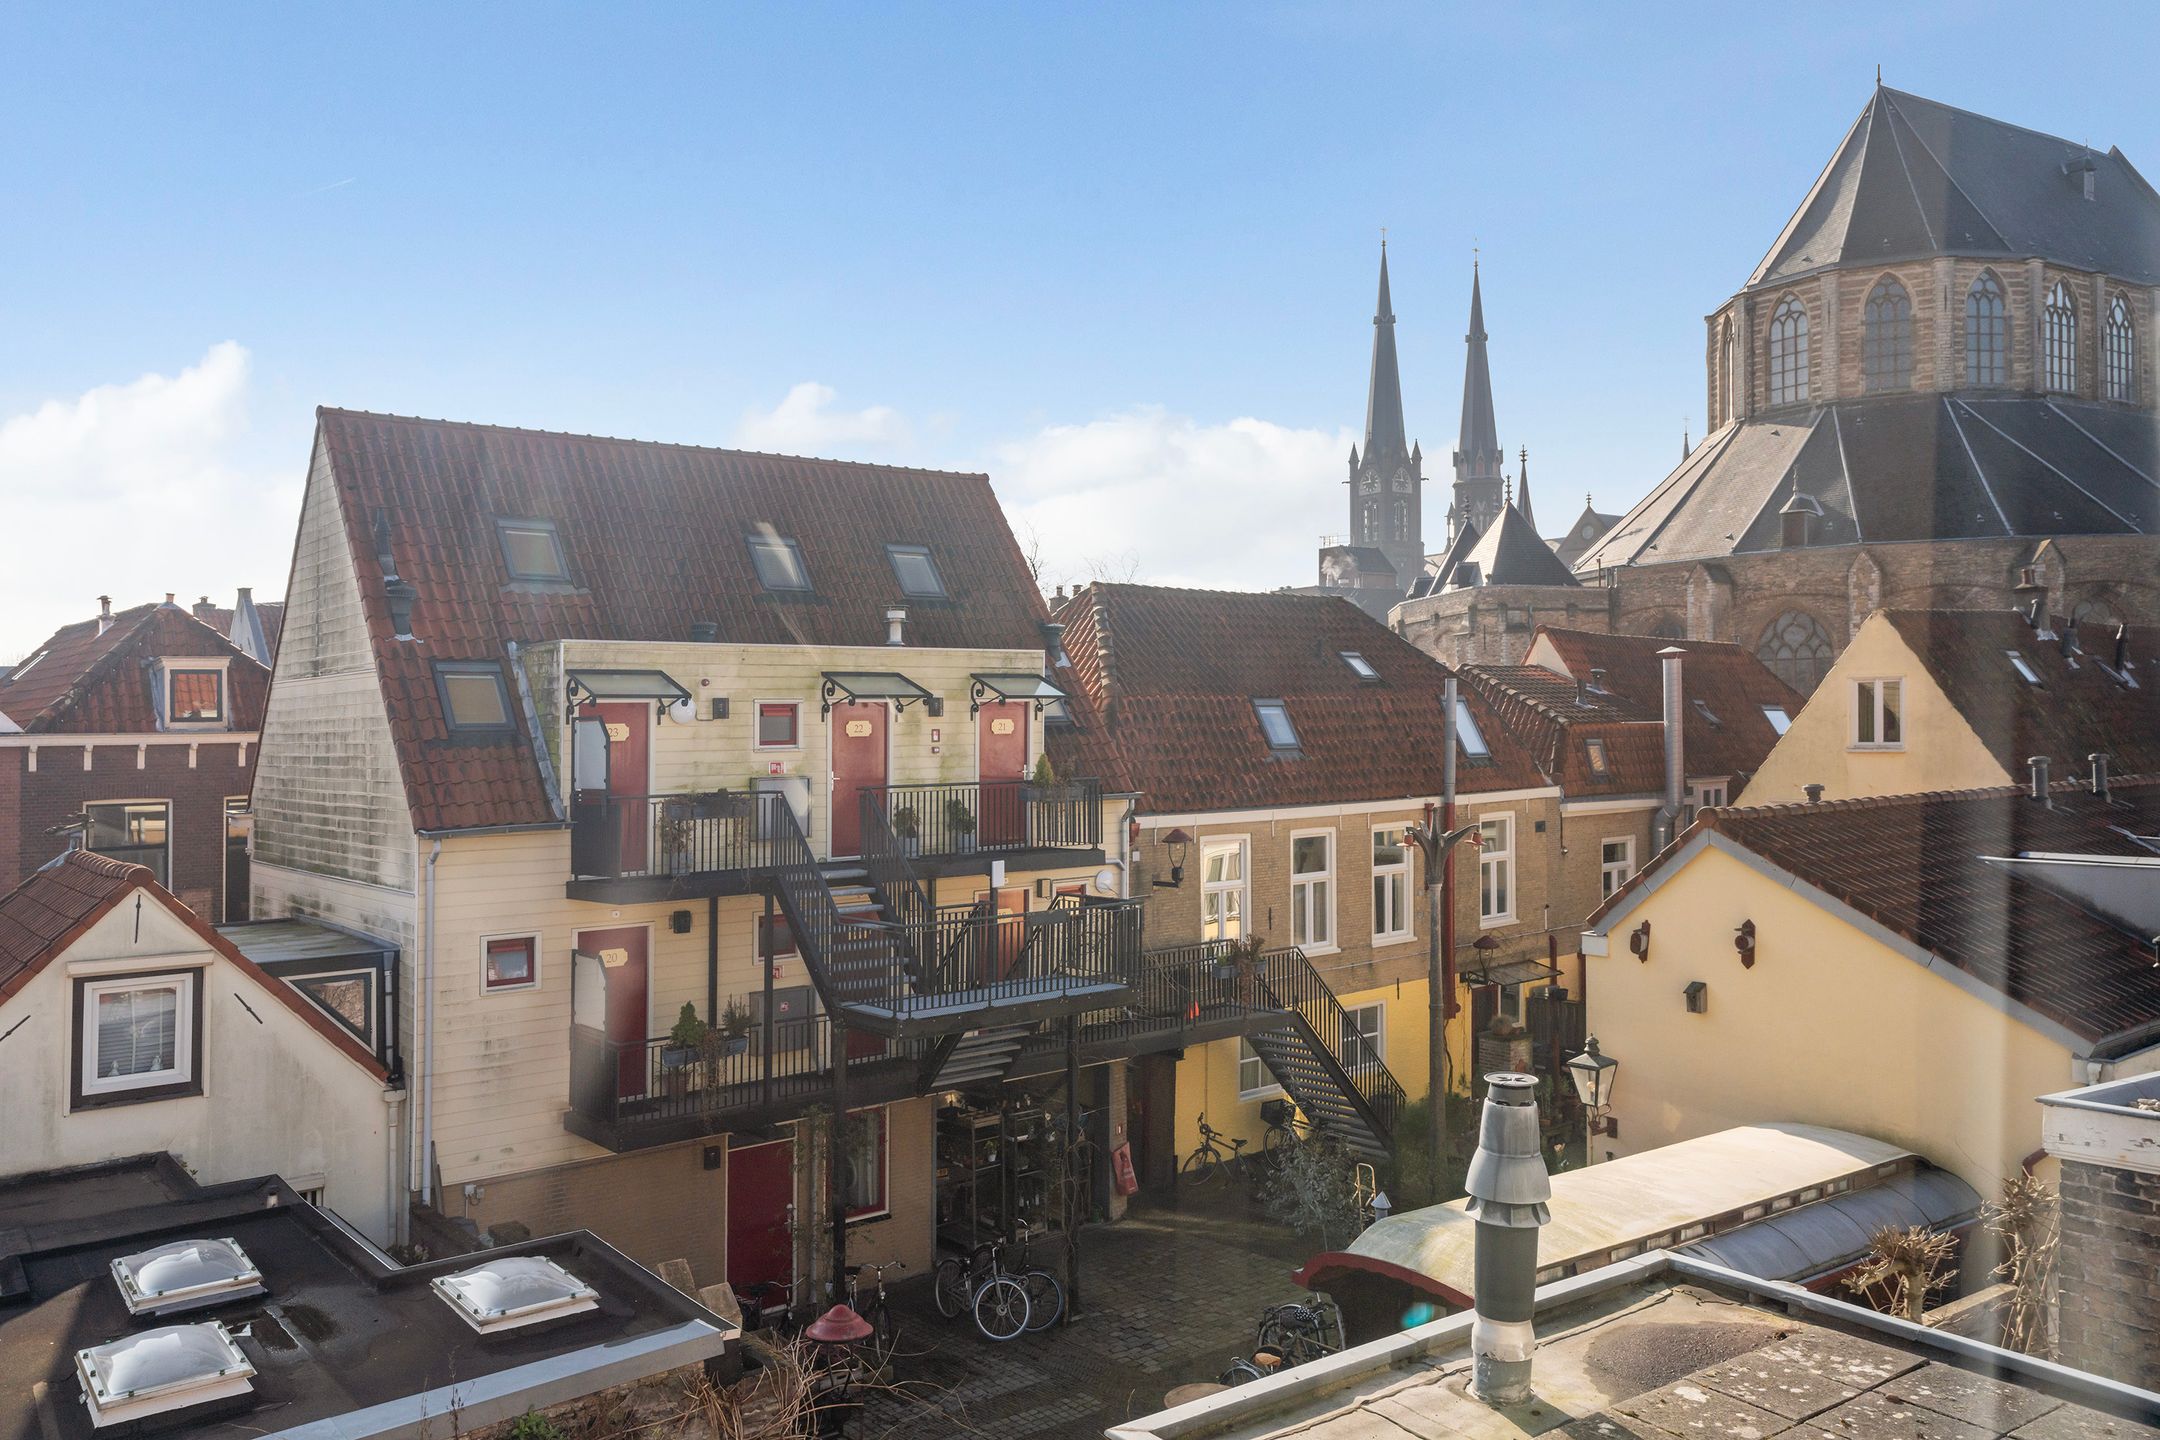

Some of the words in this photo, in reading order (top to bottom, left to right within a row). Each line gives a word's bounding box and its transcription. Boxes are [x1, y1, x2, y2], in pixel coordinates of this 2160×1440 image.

[854, 724, 864, 733] 22
[998, 722, 1006, 731] 21
[608, 727, 619, 738] 23
[606, 953, 618, 963] 20
